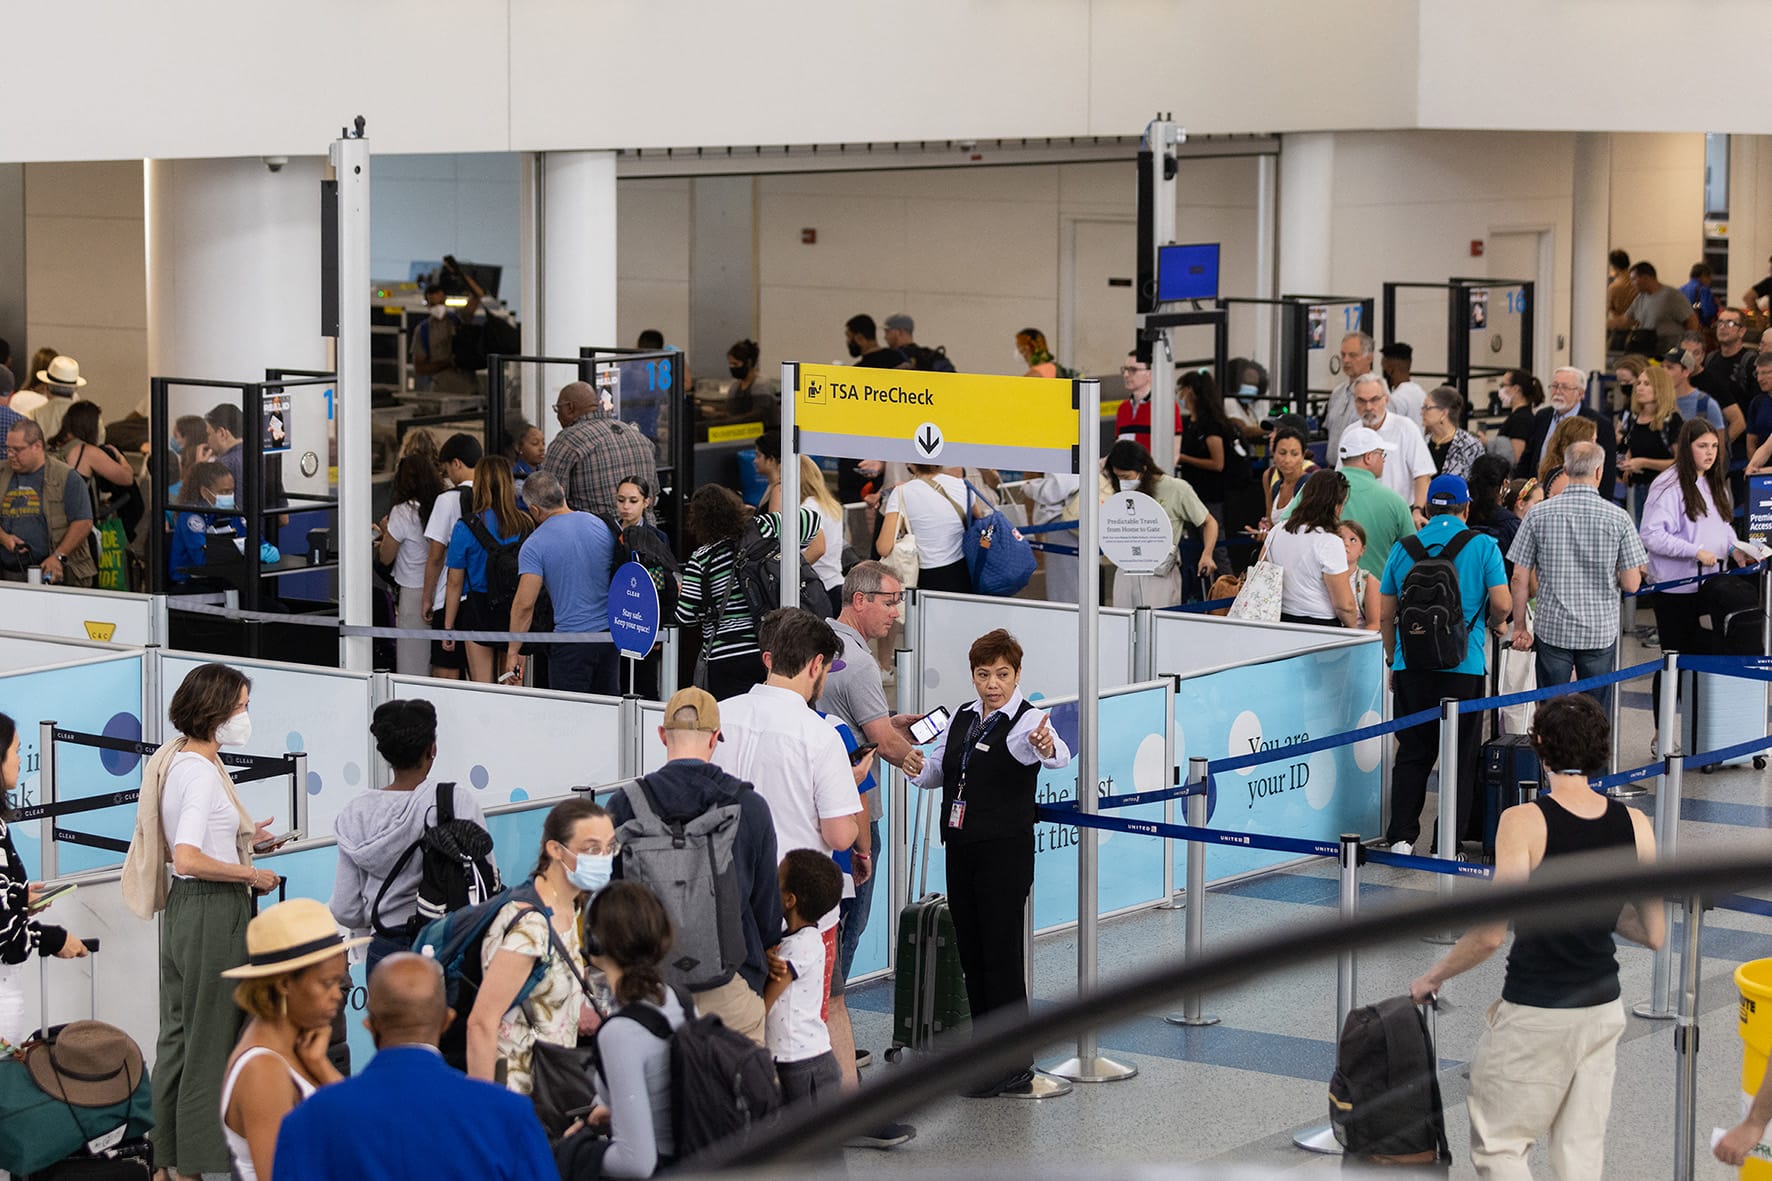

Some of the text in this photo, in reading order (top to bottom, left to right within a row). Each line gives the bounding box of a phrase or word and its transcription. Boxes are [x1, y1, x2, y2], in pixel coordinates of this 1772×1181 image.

[1506, 290, 1526, 314] 16
[1343, 306, 1362, 331] 17
[646, 358, 672, 391] 18
[830, 383, 934, 405] TSA PreCheck
[626, 589, 640, 598] CLEAR
[622, 608, 632, 620] Stay
[614, 616, 650, 634] Keep your space!
[1038, 782, 1069, 803] the
[1248, 762, 1310, 809] your ID
[24, 808, 44, 817] CLEAR
[1049, 822, 1079, 850] the
[1128, 824, 1150, 832] UNITED
